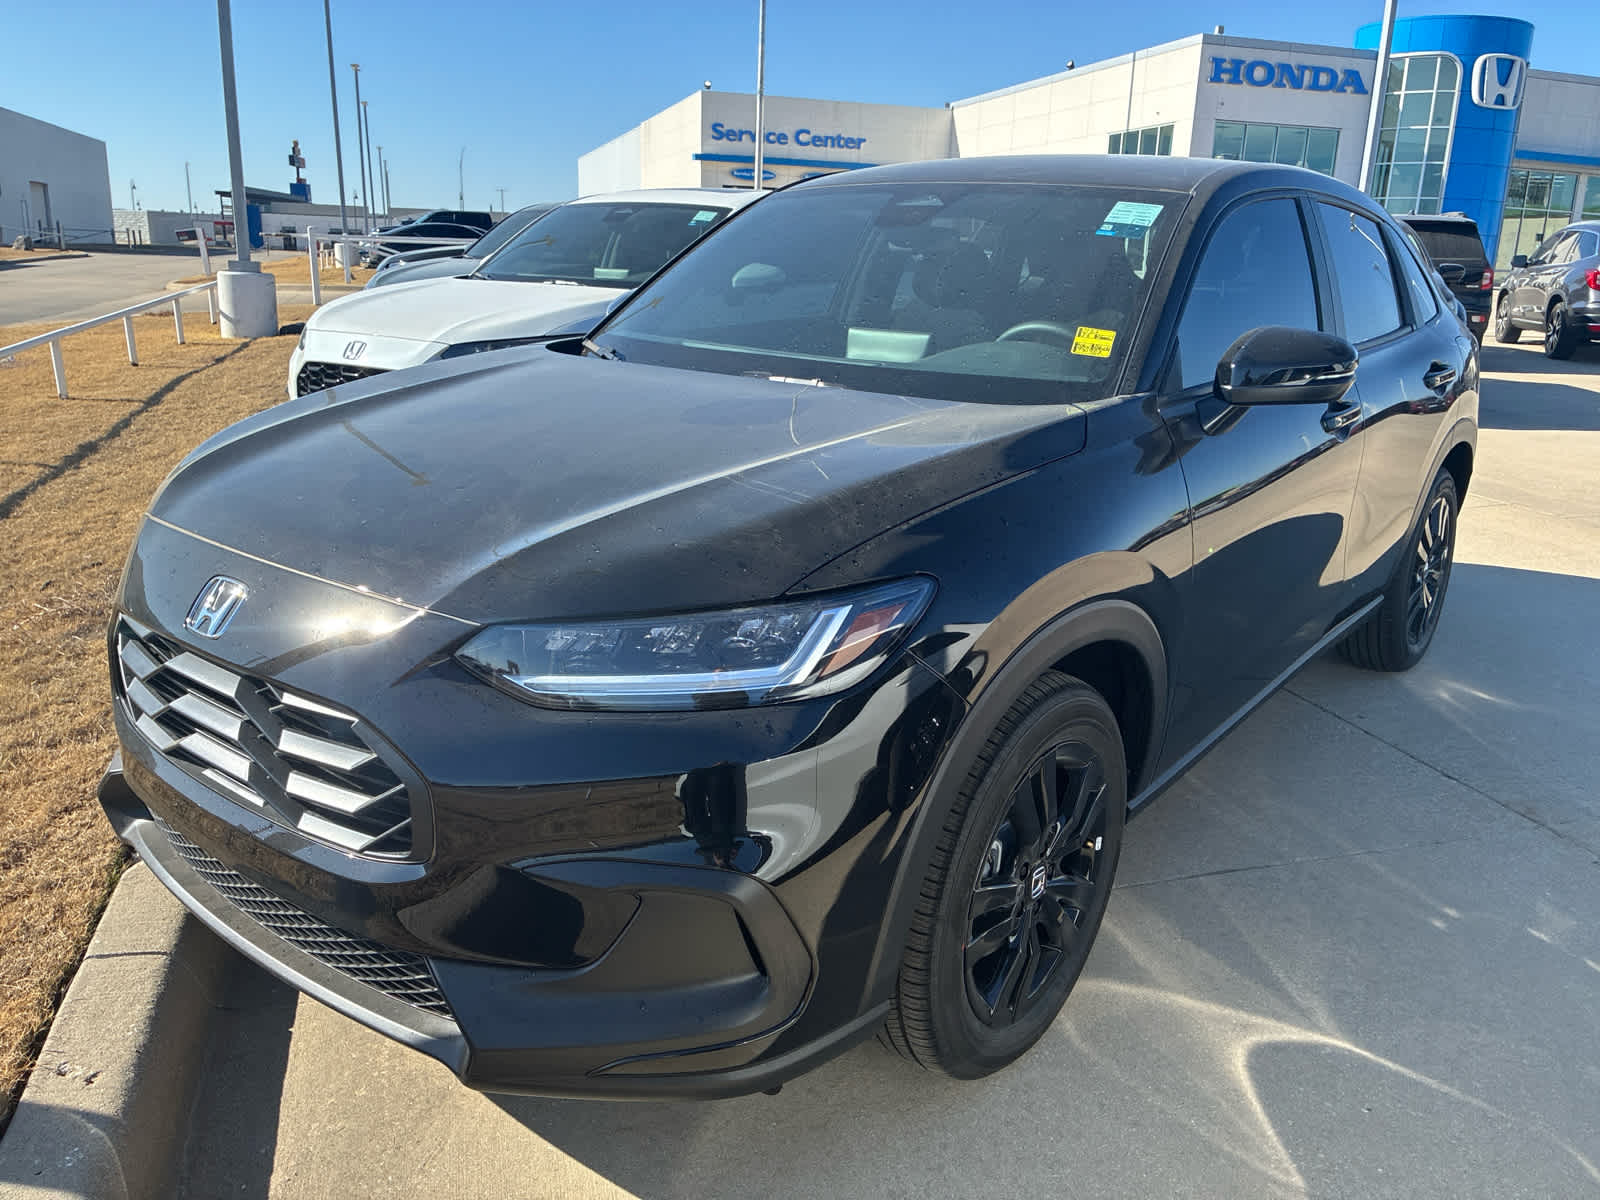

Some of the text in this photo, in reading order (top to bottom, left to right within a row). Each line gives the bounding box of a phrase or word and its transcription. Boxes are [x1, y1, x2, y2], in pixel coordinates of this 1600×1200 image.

[1208, 56, 1369, 95] HONDA
[711, 122, 867, 150] Servce Center
